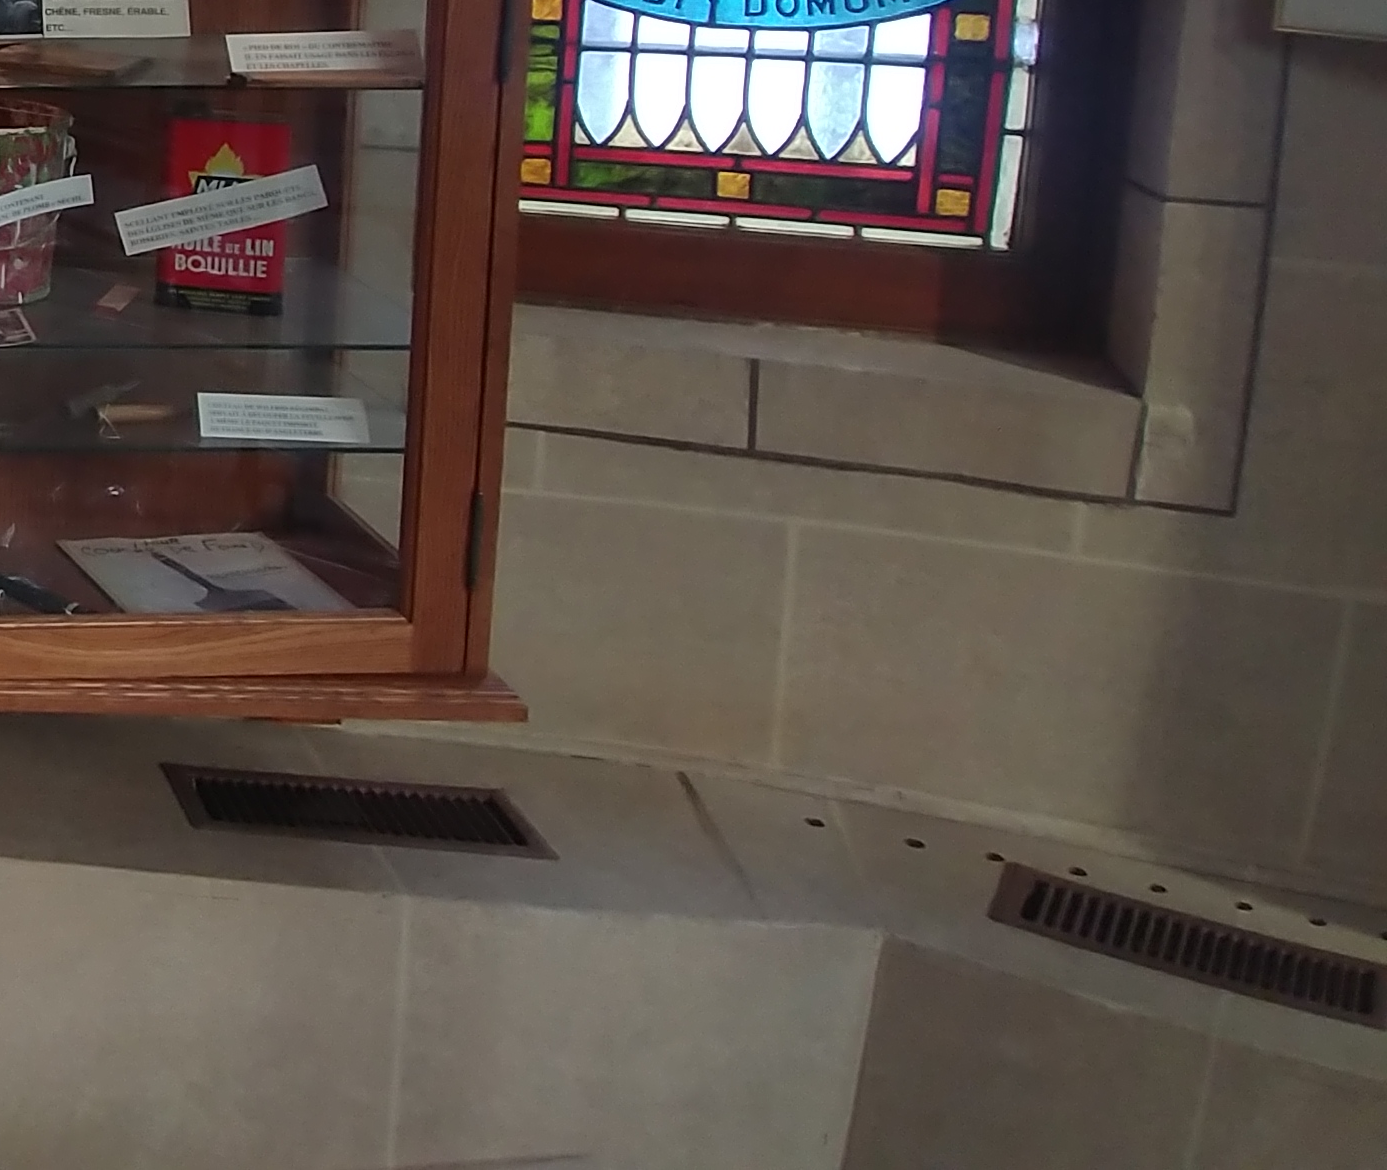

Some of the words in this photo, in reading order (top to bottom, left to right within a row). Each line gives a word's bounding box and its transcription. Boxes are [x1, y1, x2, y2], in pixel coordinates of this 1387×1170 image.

[226, 243, 241, 254] DE
[246, 238, 274, 256] LIN
[175, 254, 267, 278] BOUILLIE
